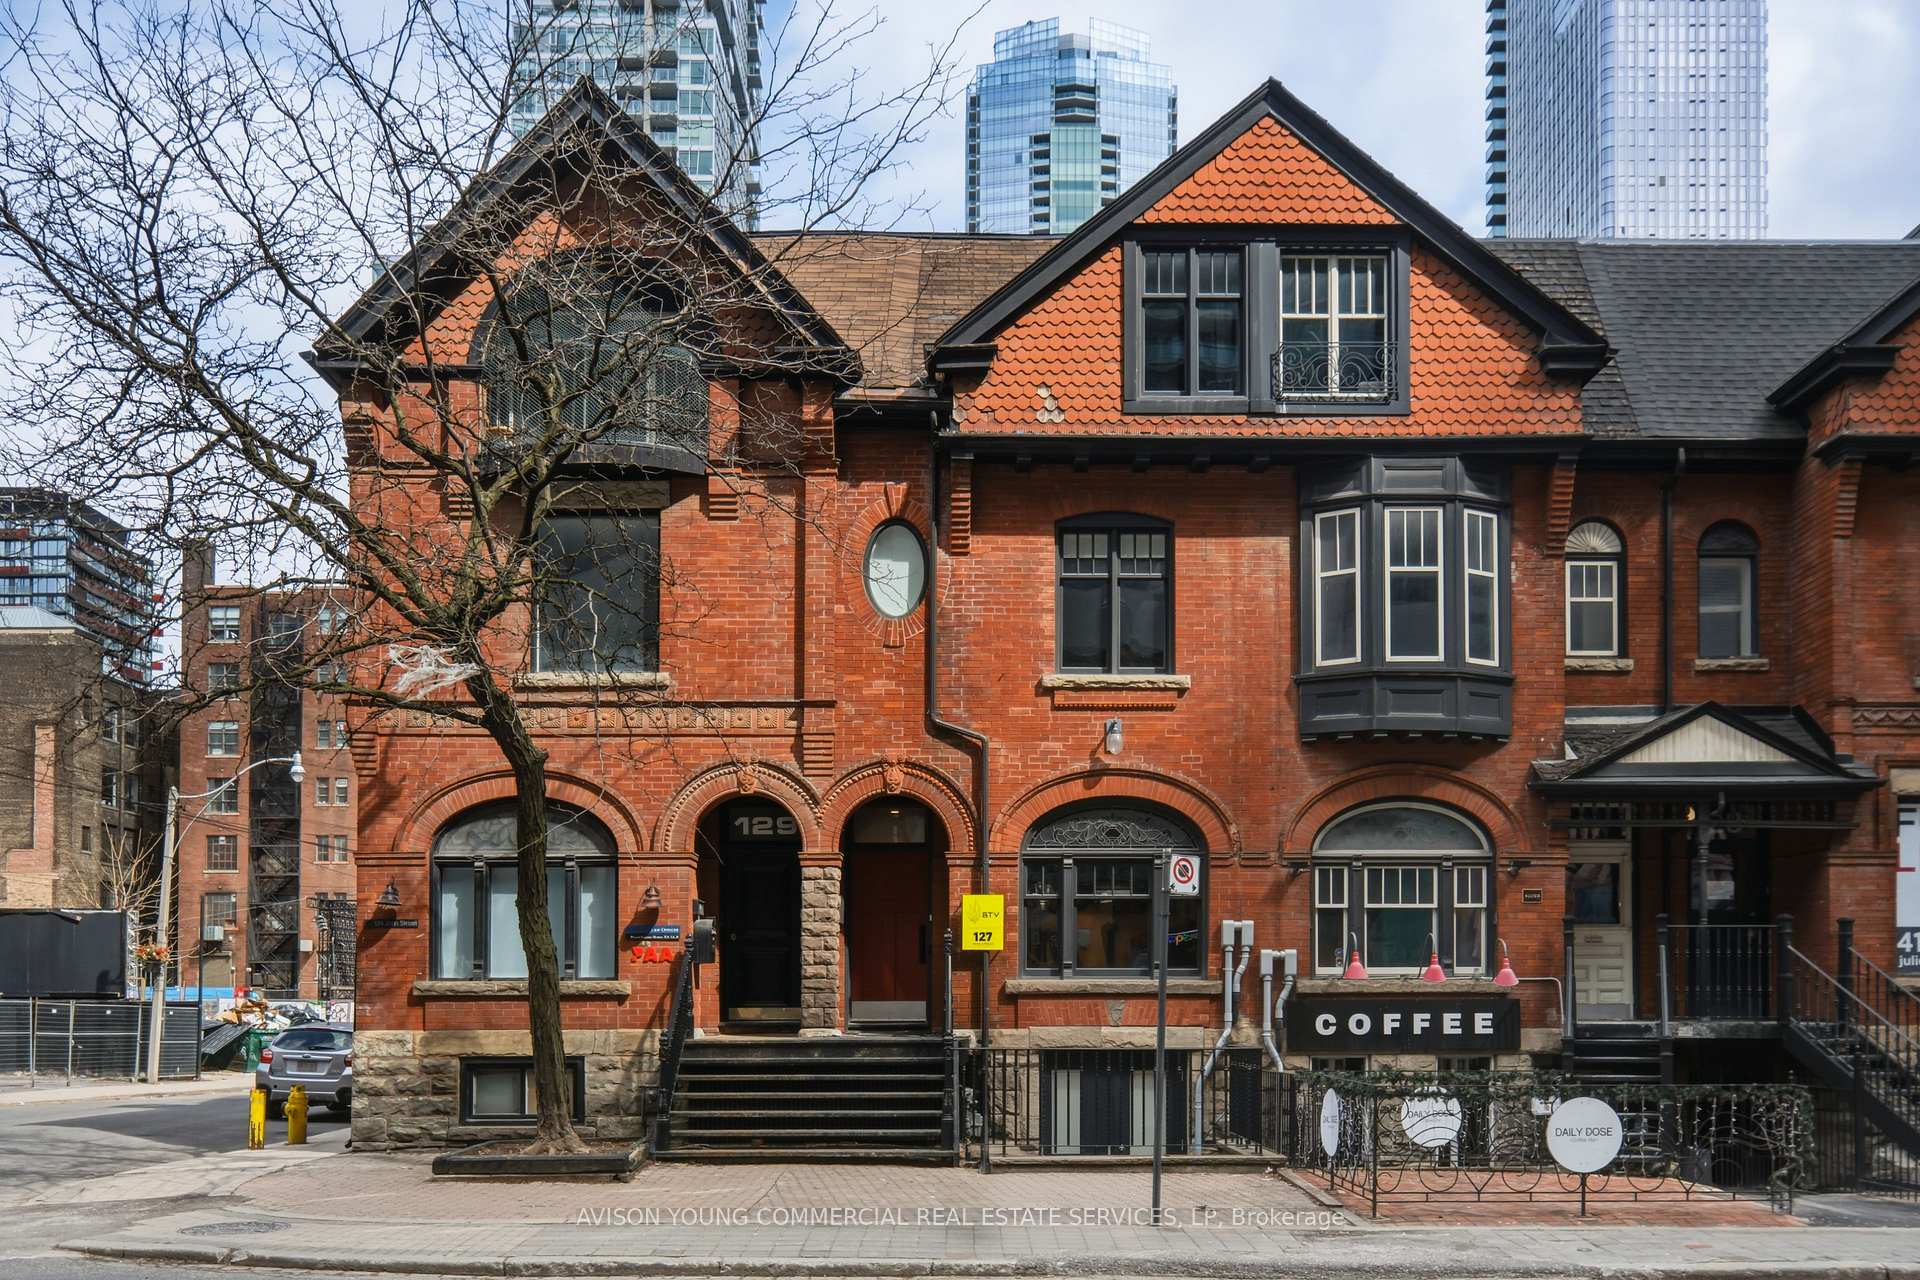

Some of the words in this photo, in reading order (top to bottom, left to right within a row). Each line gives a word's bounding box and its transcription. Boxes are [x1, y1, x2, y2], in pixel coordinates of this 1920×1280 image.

[734, 816, 797, 835] 129
[973, 931, 993, 942] 127
[1897, 954, 1920, 968] juli
[1315, 1012, 1494, 1036] COFFEE
[1555, 1127, 1583, 1137] DAILY
[1585, 1127, 1613, 1137] DOSE
